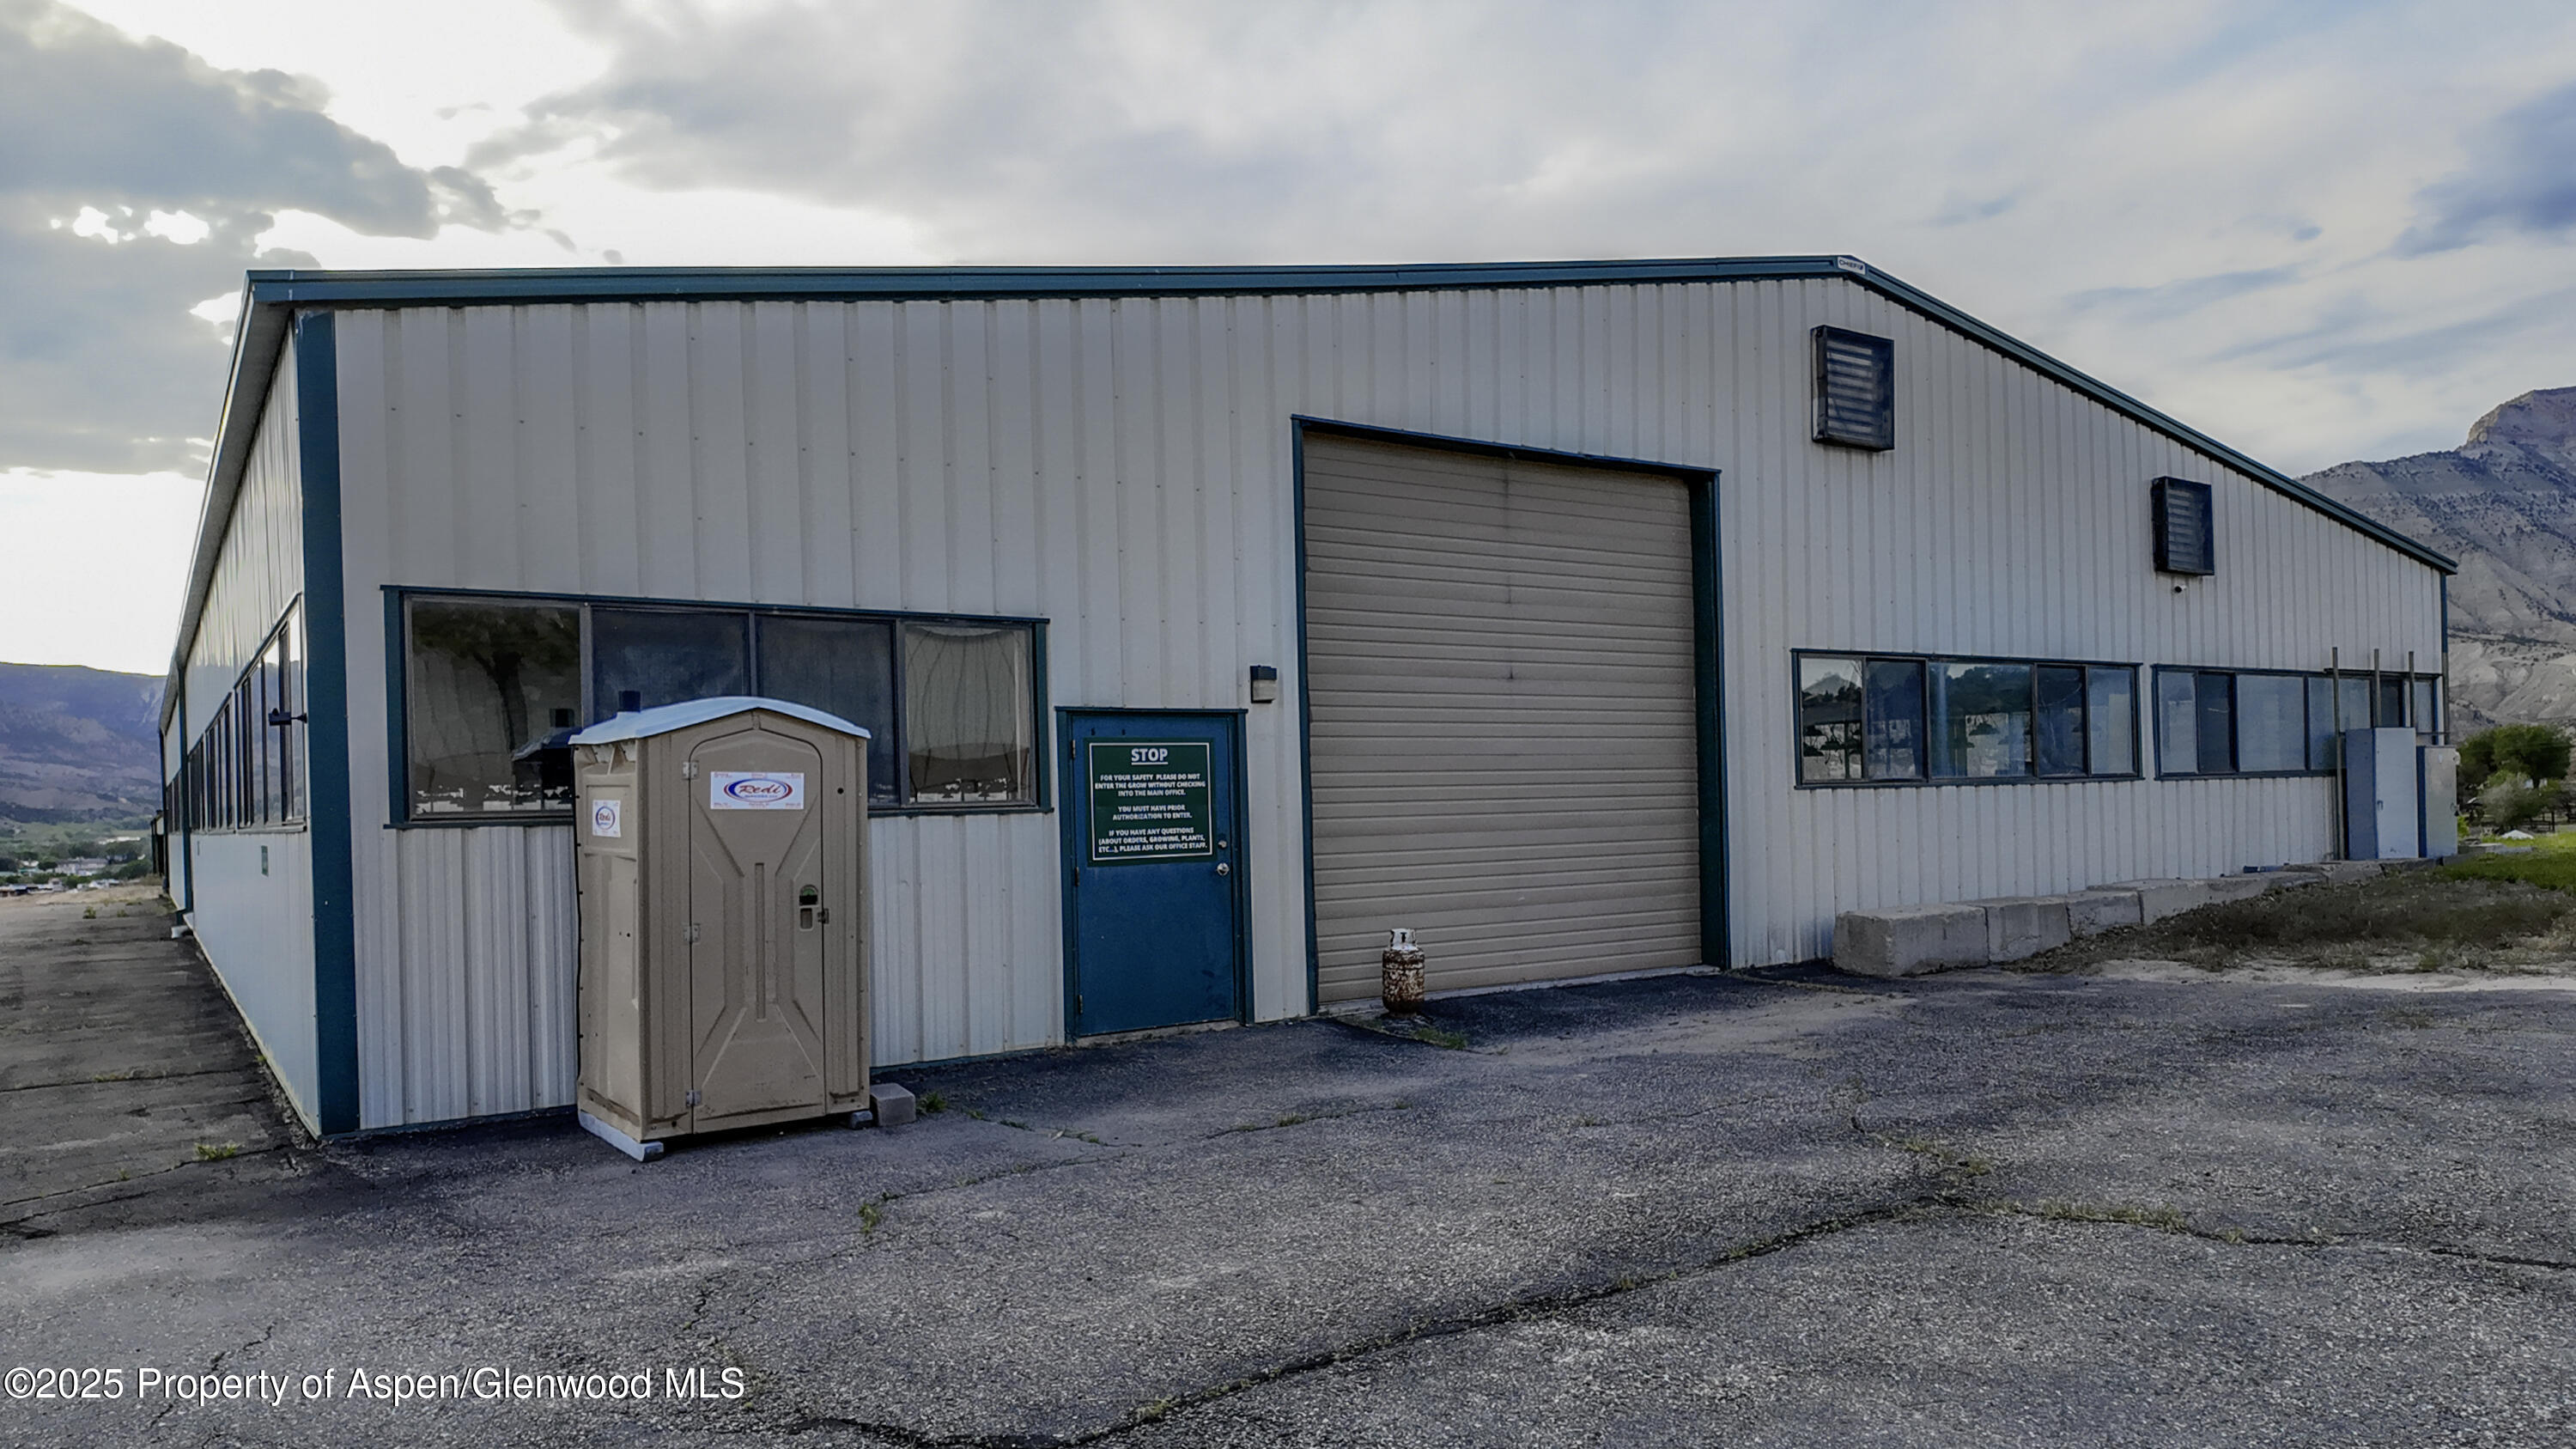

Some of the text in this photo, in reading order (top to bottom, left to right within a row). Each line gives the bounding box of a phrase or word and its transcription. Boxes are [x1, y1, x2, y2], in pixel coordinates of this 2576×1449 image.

[1131, 748, 1169, 762] STOP
[738, 784, 781, 794] Redi
[1113, 813, 1163, 821] AUTHORIZATION
